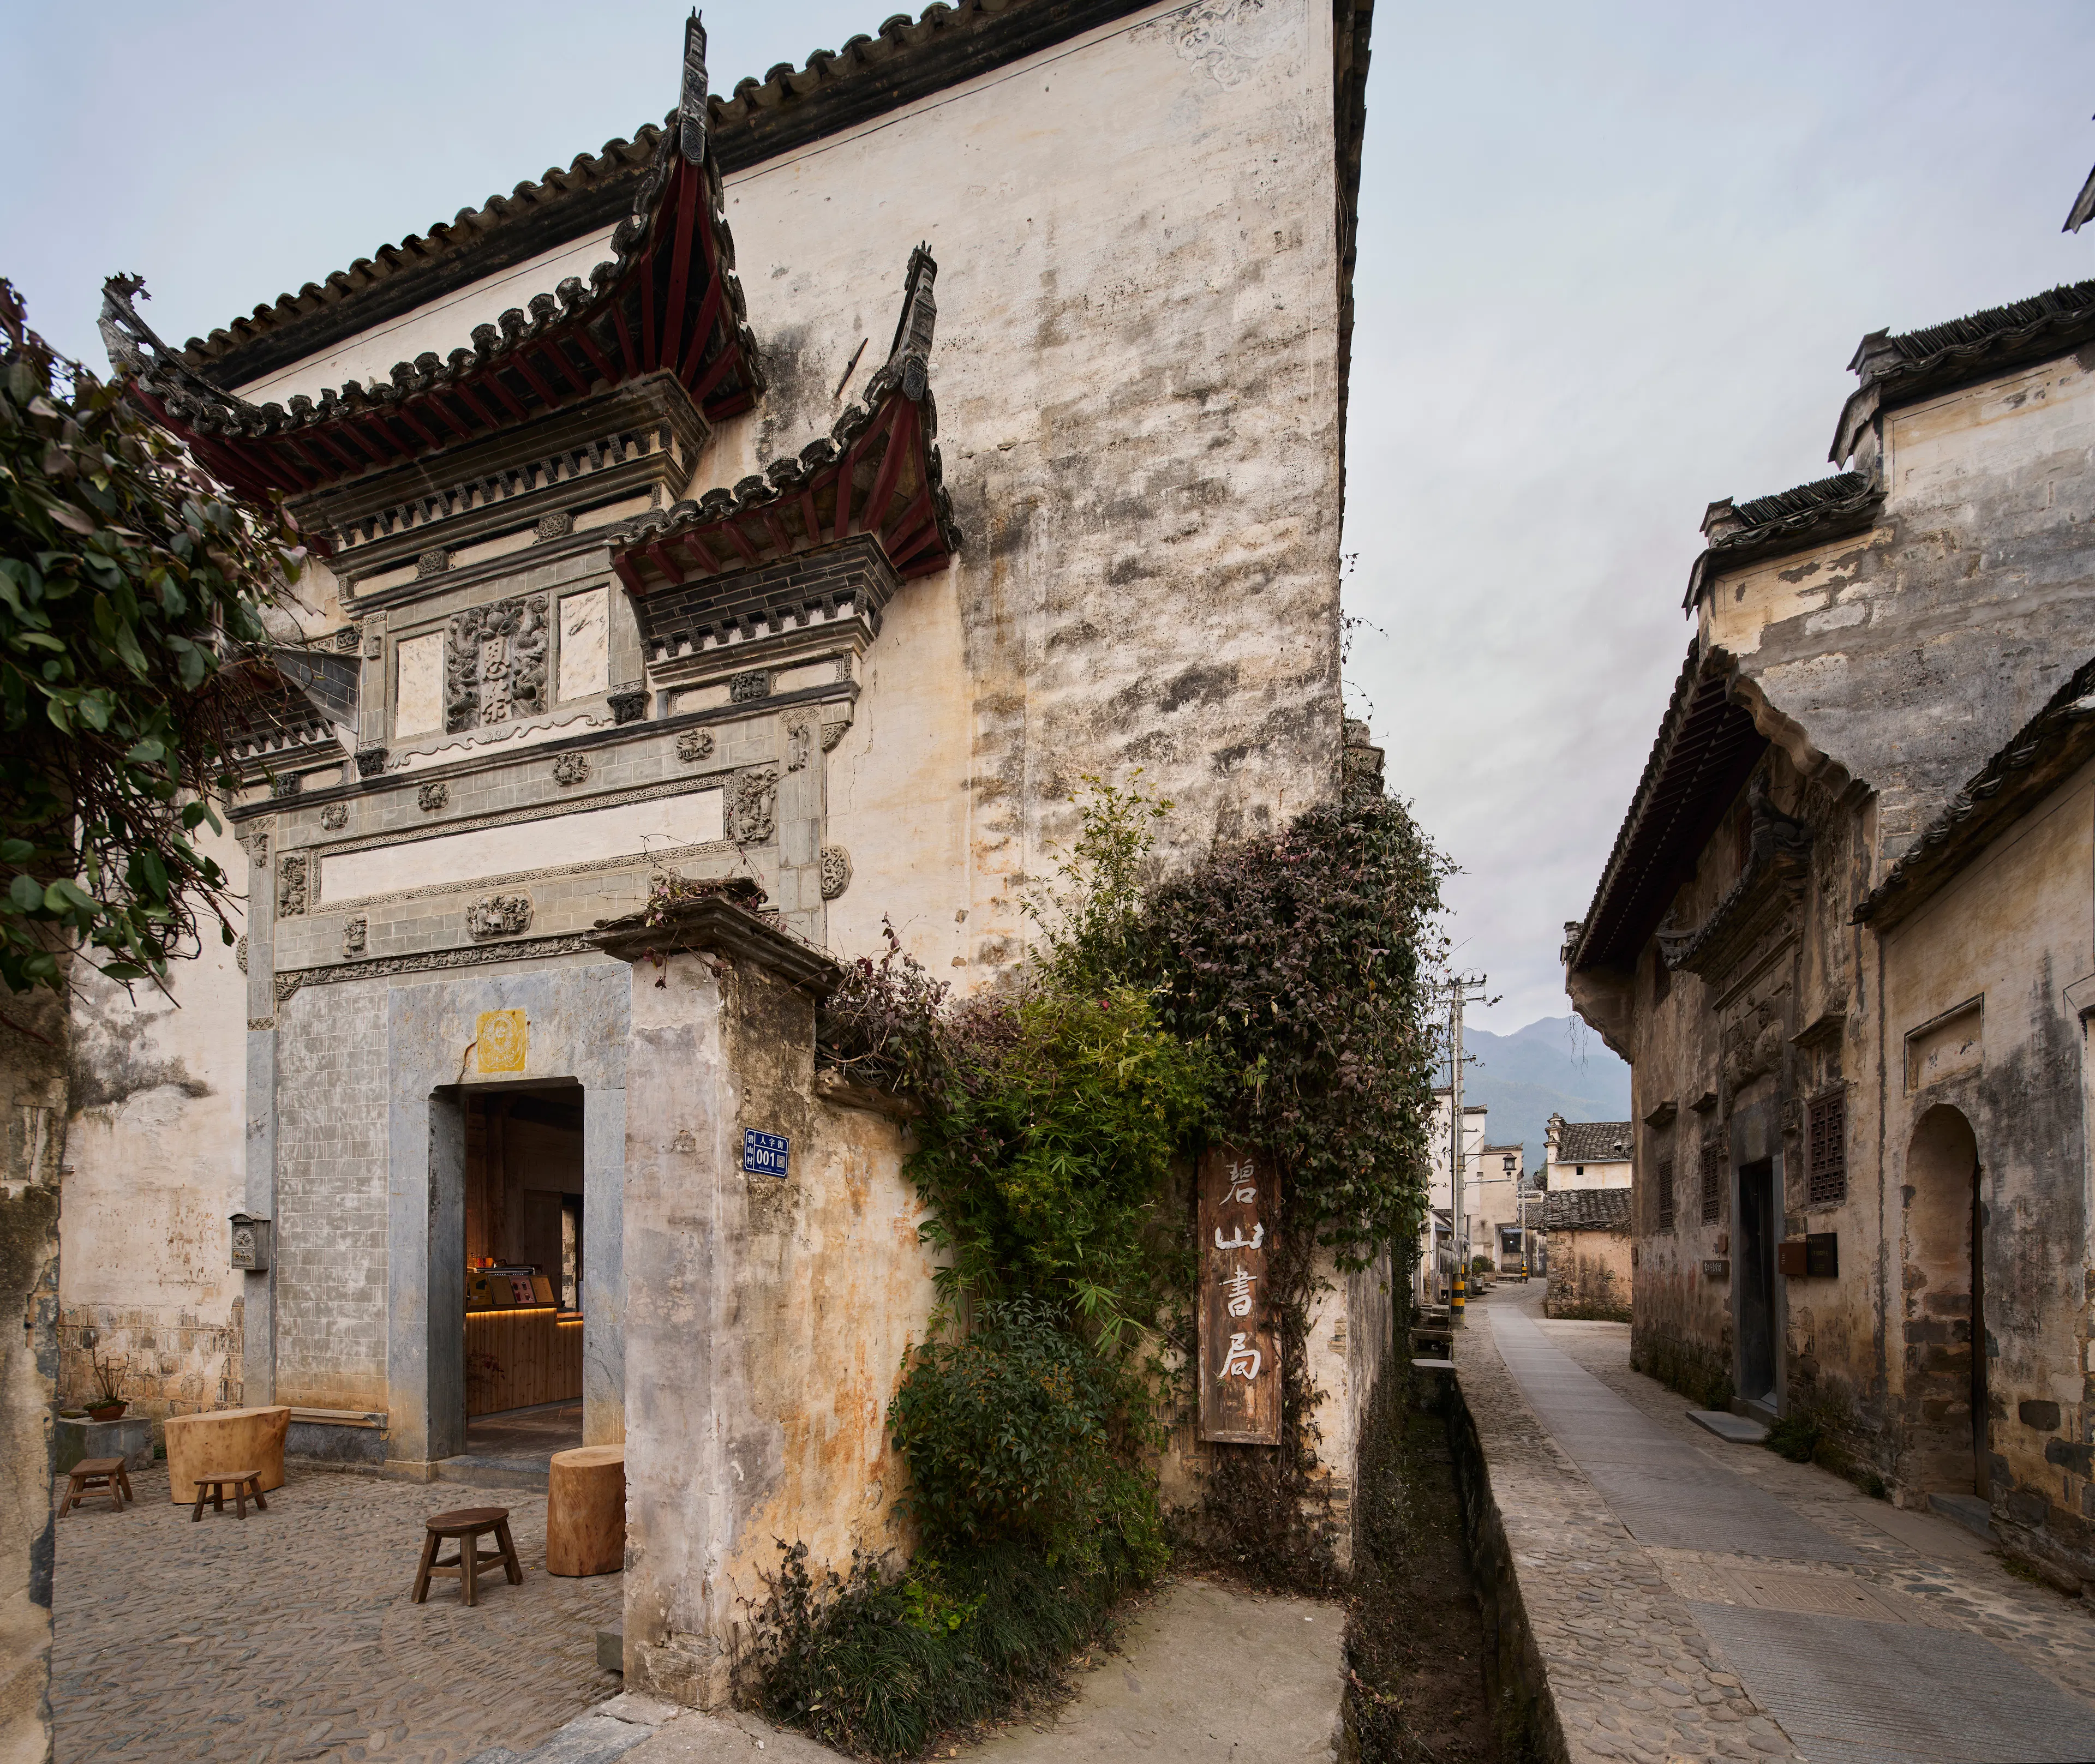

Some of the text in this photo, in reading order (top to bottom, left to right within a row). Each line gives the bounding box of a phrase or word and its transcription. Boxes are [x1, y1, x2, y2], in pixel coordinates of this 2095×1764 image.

[760, 1136, 784, 1149] 人字街
[756, 1149, 775, 1167] 001
[1214, 1158, 1265, 1380] 碧山書局
